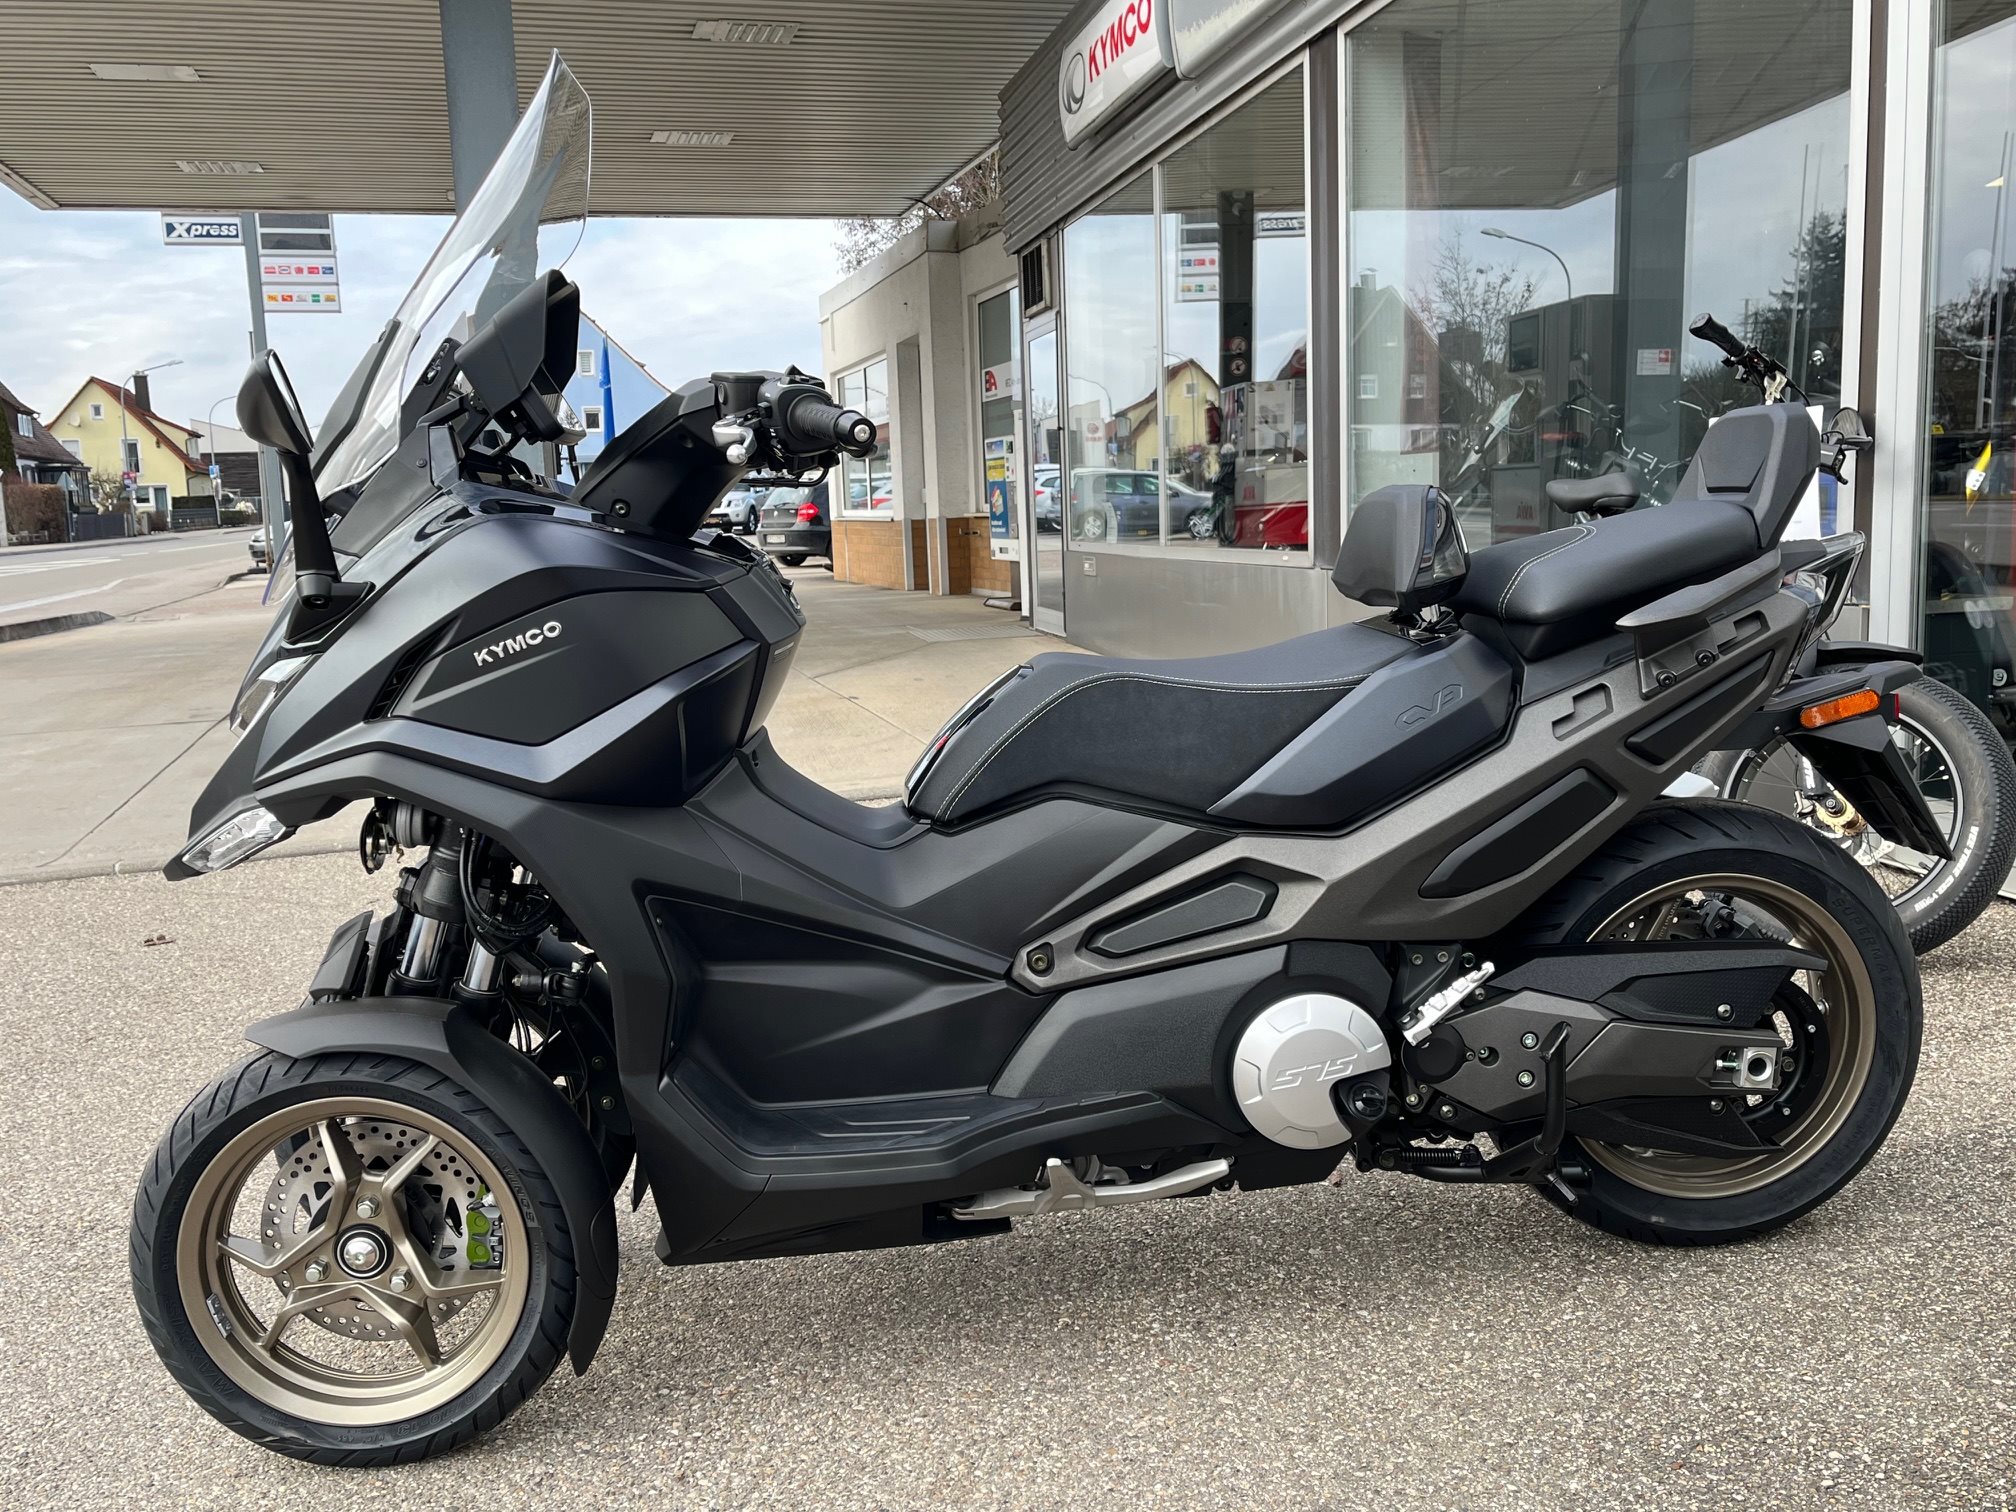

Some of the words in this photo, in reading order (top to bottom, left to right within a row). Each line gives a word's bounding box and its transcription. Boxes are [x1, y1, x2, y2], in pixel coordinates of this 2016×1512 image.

[1089, 0, 1152, 82] KYMCO
[167, 222, 239, 238] Xpress
[473, 621, 562, 667] KYMCO
